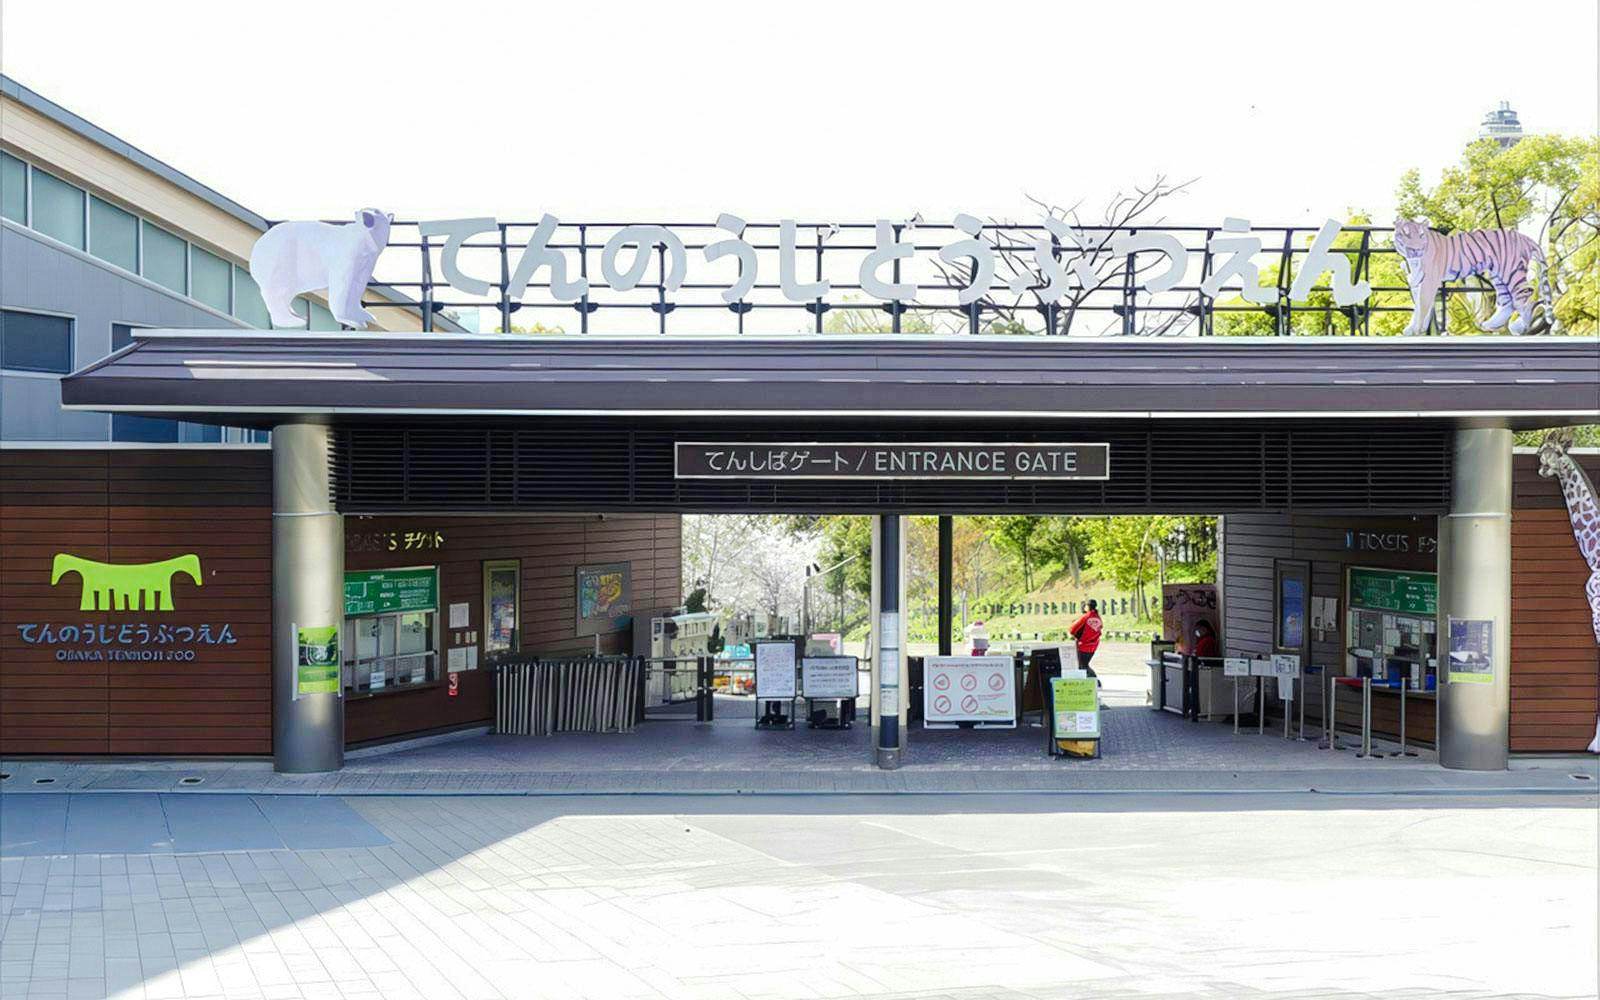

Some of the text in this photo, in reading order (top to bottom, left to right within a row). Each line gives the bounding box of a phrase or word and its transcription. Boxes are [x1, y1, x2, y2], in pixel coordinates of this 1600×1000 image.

[417, 212, 1371, 308] てんのうじどうぶつえん
[705, 451, 849, 471] てんしばゲート
[875, 451, 1005, 471] ENTRANCE
[1015, 451, 1077, 471] GATE
[16, 623, 237, 645] てんのうじどうぶつえん
